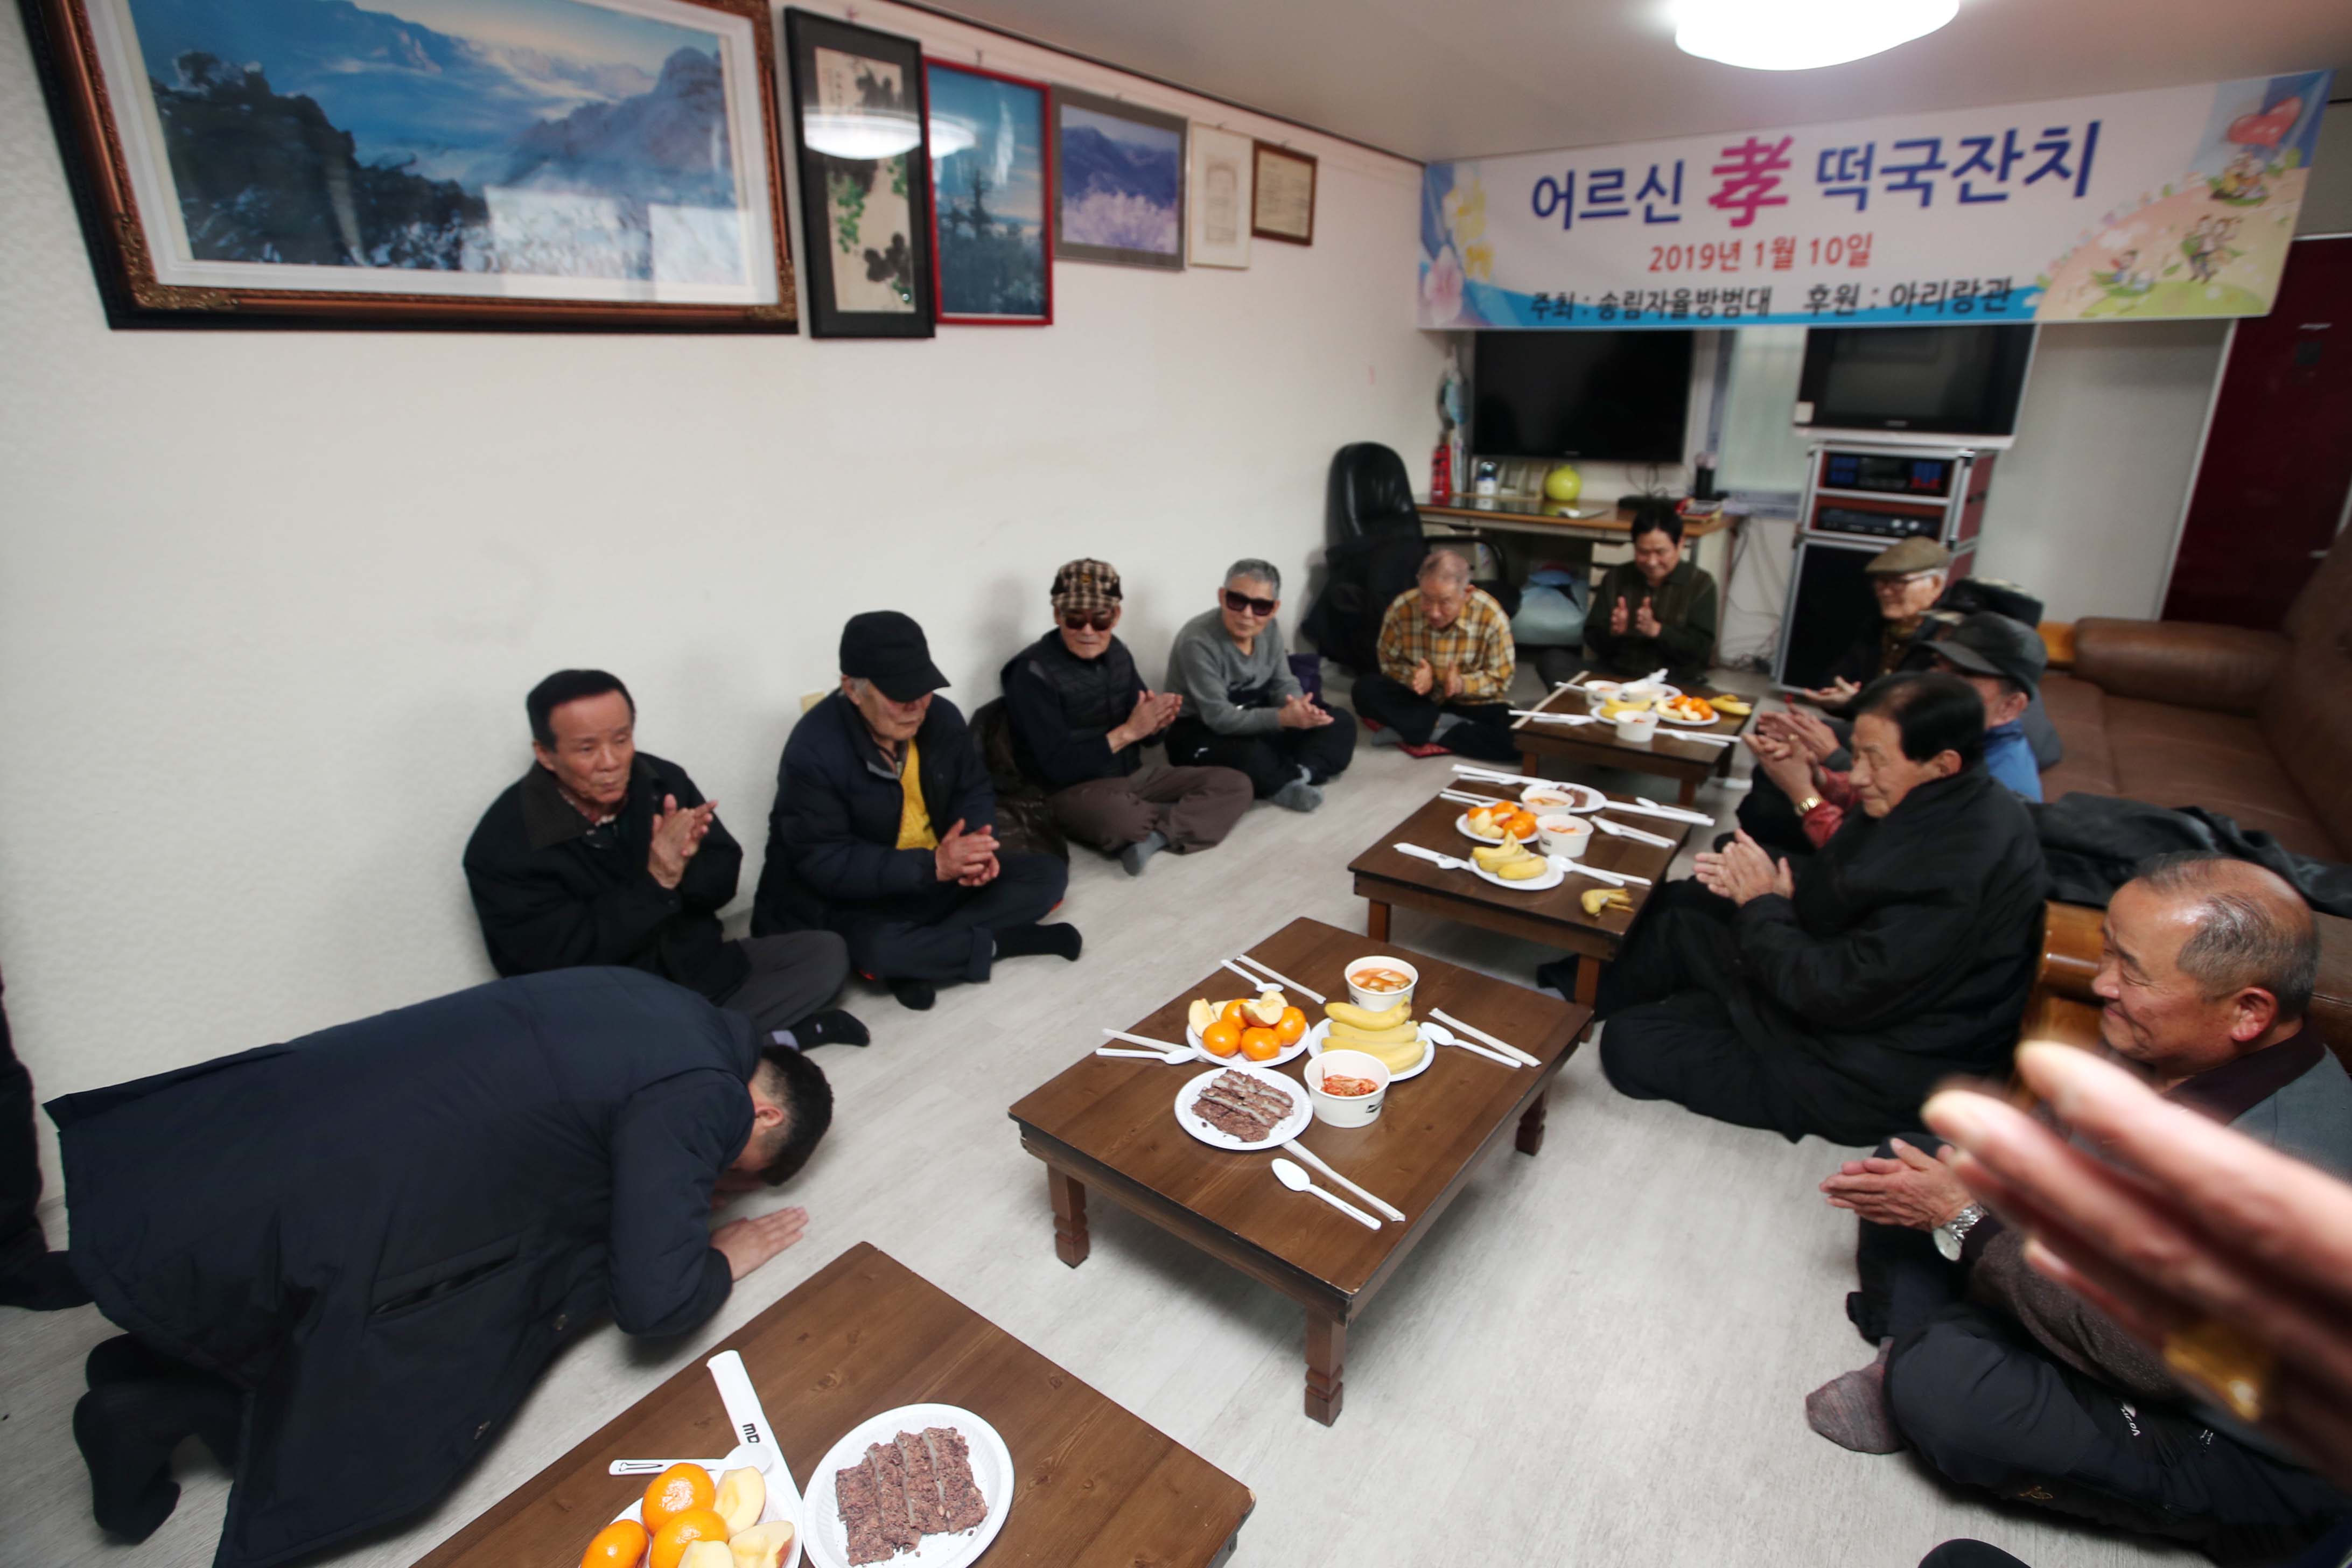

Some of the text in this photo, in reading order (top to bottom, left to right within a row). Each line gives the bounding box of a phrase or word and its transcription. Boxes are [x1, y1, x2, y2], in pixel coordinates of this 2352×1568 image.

[1531, 118, 2103, 230] 어르신 孝 떡국잔치
[1648, 232, 1874, 273] 2019년 1월 10일
[1530, 290, 1575, 321] 주최
[1597, 285, 1773, 321] 송림자율방범대
[1803, 281, 1861, 317] 후원
[1888, 275, 2013, 314] 아리랑관
